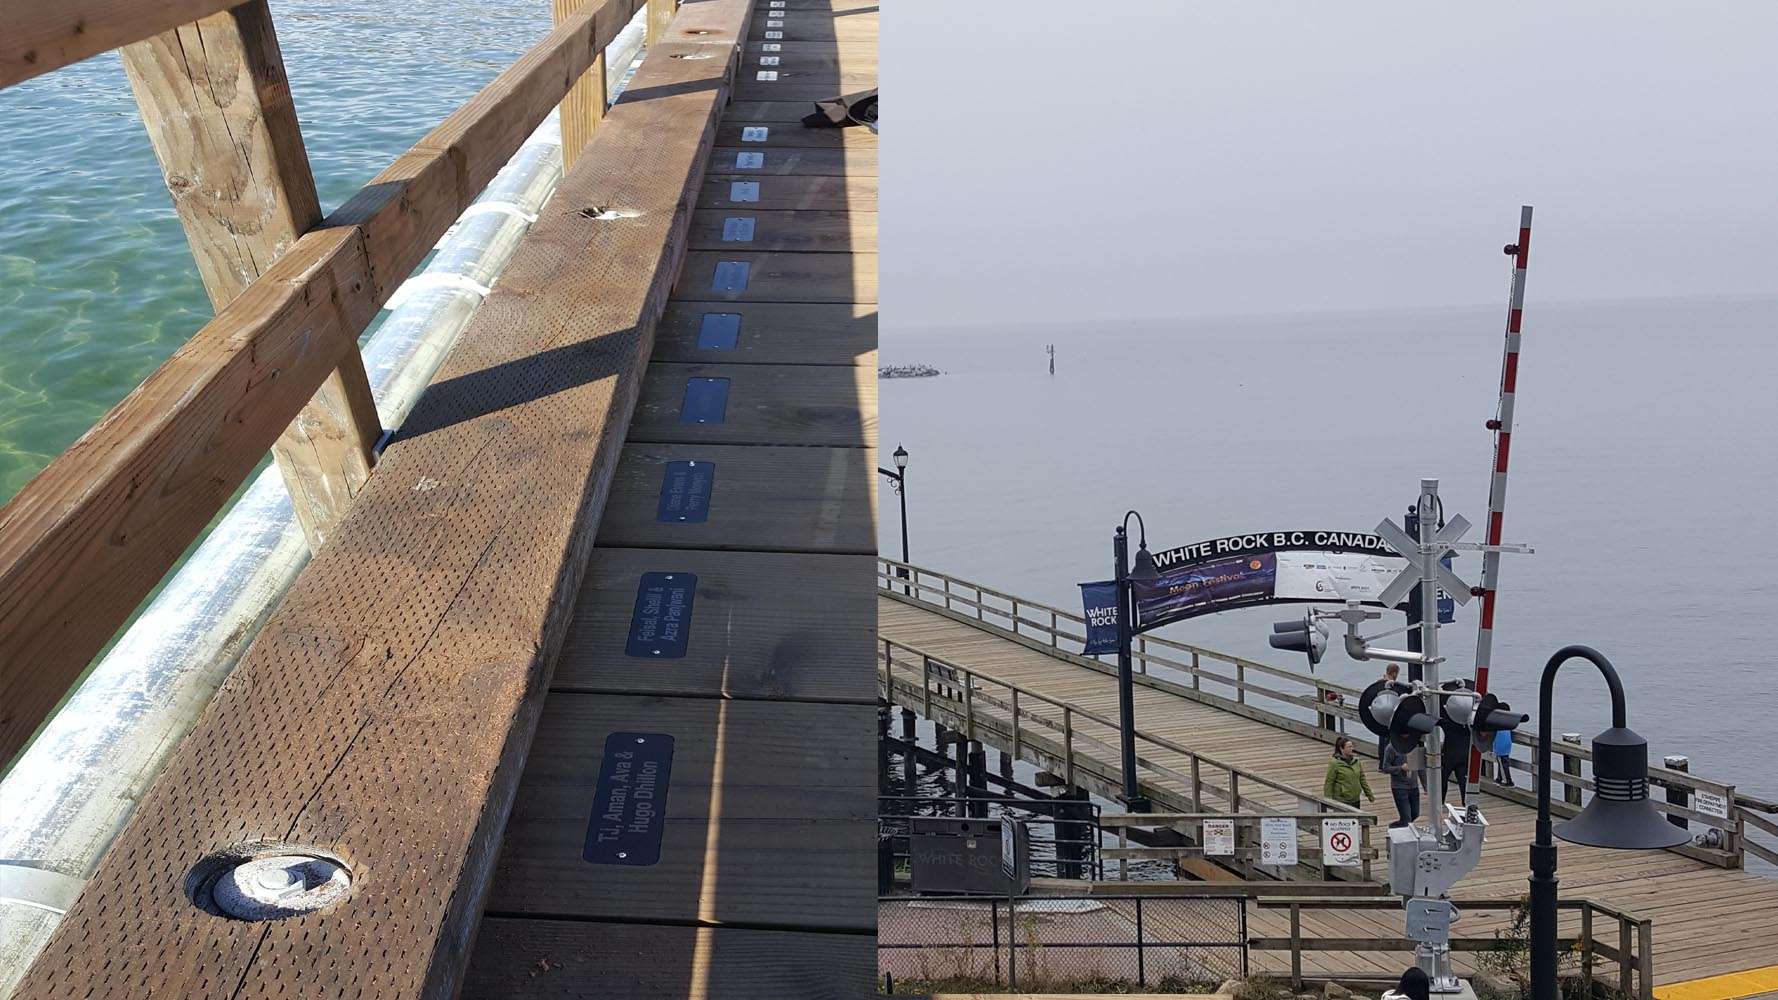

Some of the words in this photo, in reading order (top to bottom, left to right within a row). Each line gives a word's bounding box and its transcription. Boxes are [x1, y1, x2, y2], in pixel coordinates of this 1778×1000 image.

[1152, 542, 1212, 568] WHITE
[1216, 534, 1268, 553] ROCK
[1273, 532, 1309, 546] B.C.
[1086, 606, 1118, 618] WHITE
[1091, 616, 1117, 627] ROCK
[615, 751, 633, 760] &
[609, 762, 632, 783] Ava
[633, 761, 658, 799] Dhillon
[602, 785, 632, 822] Aman,
[628, 802, 656, 833] Hugo
